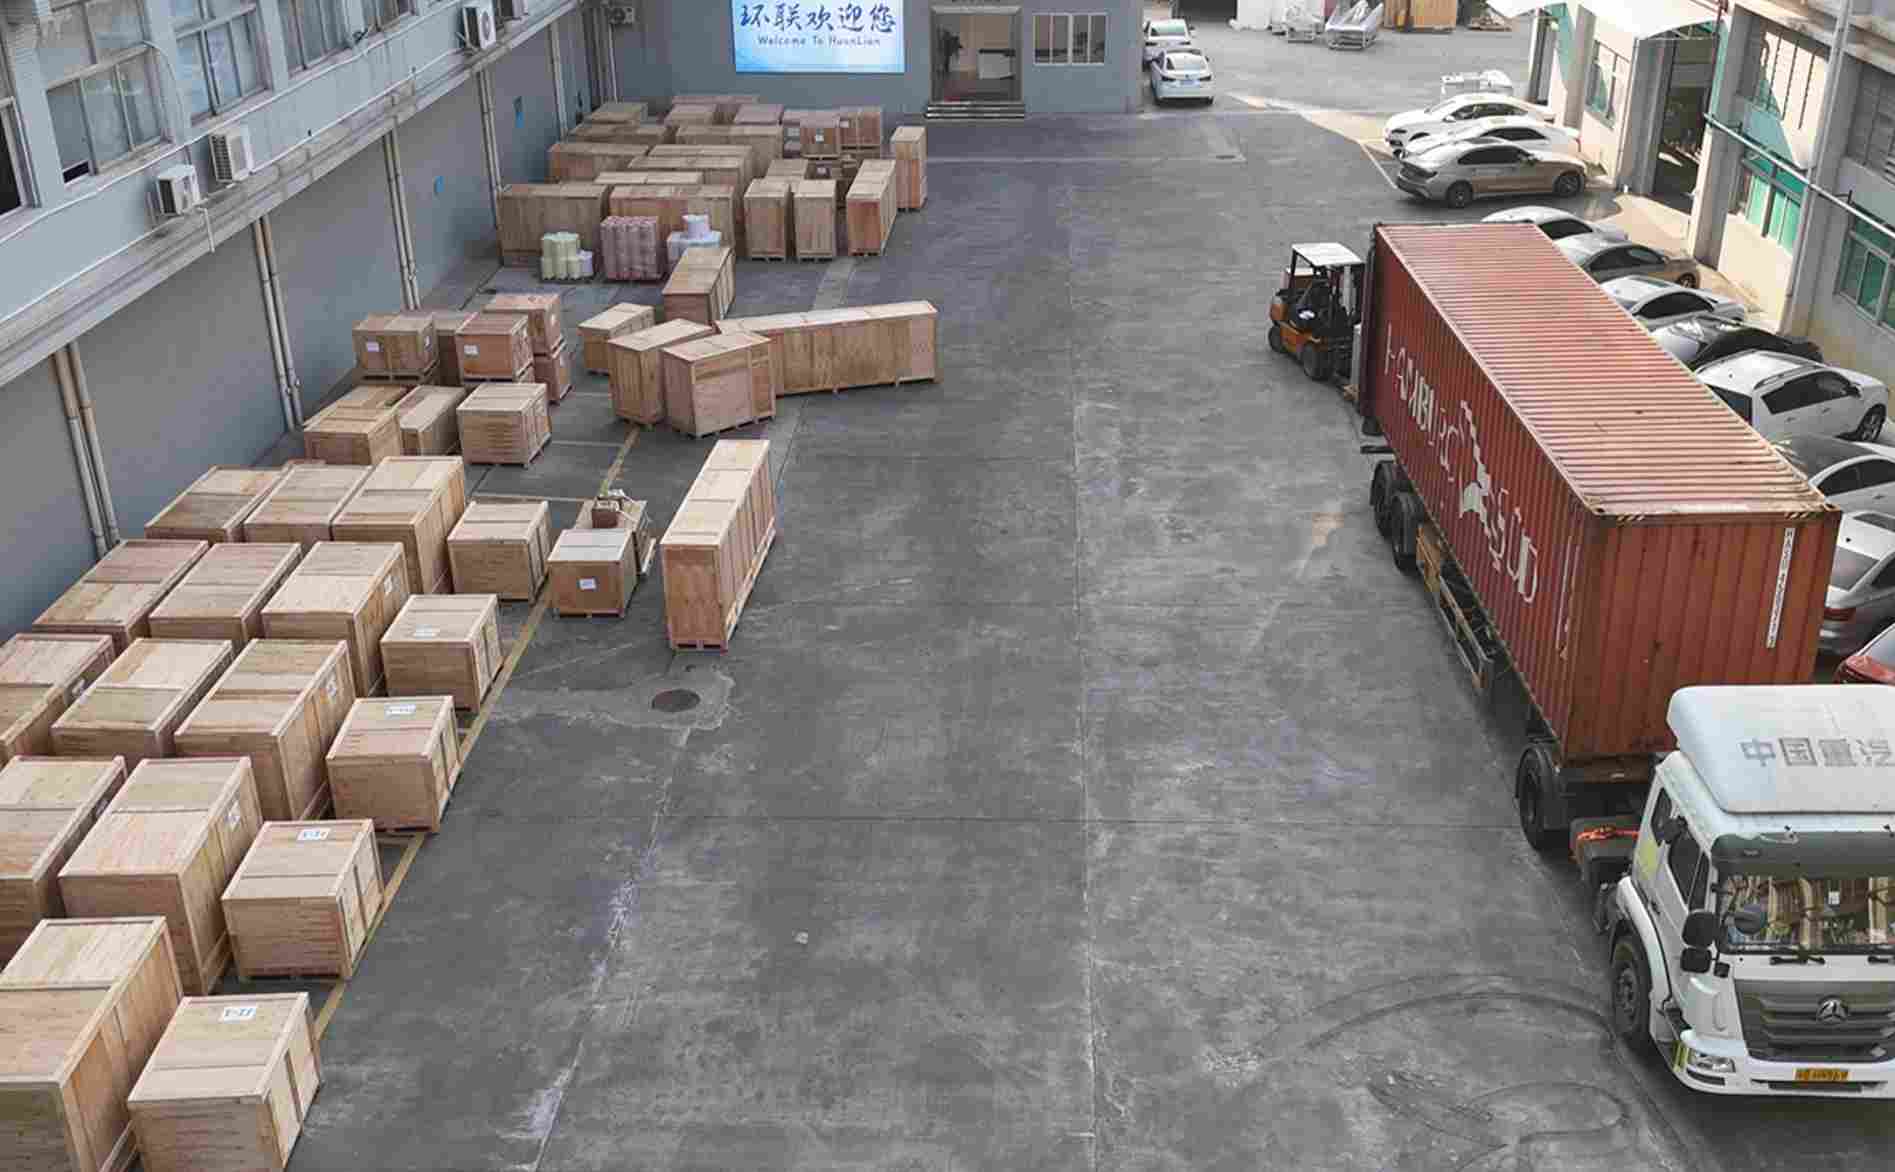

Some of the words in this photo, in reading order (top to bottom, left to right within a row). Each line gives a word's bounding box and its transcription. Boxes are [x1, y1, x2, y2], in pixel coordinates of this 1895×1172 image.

[740, 3, 896, 33] 环联欢迎您
[757, 34, 806, 46] Welcome
[812, 34, 824, 46] To
